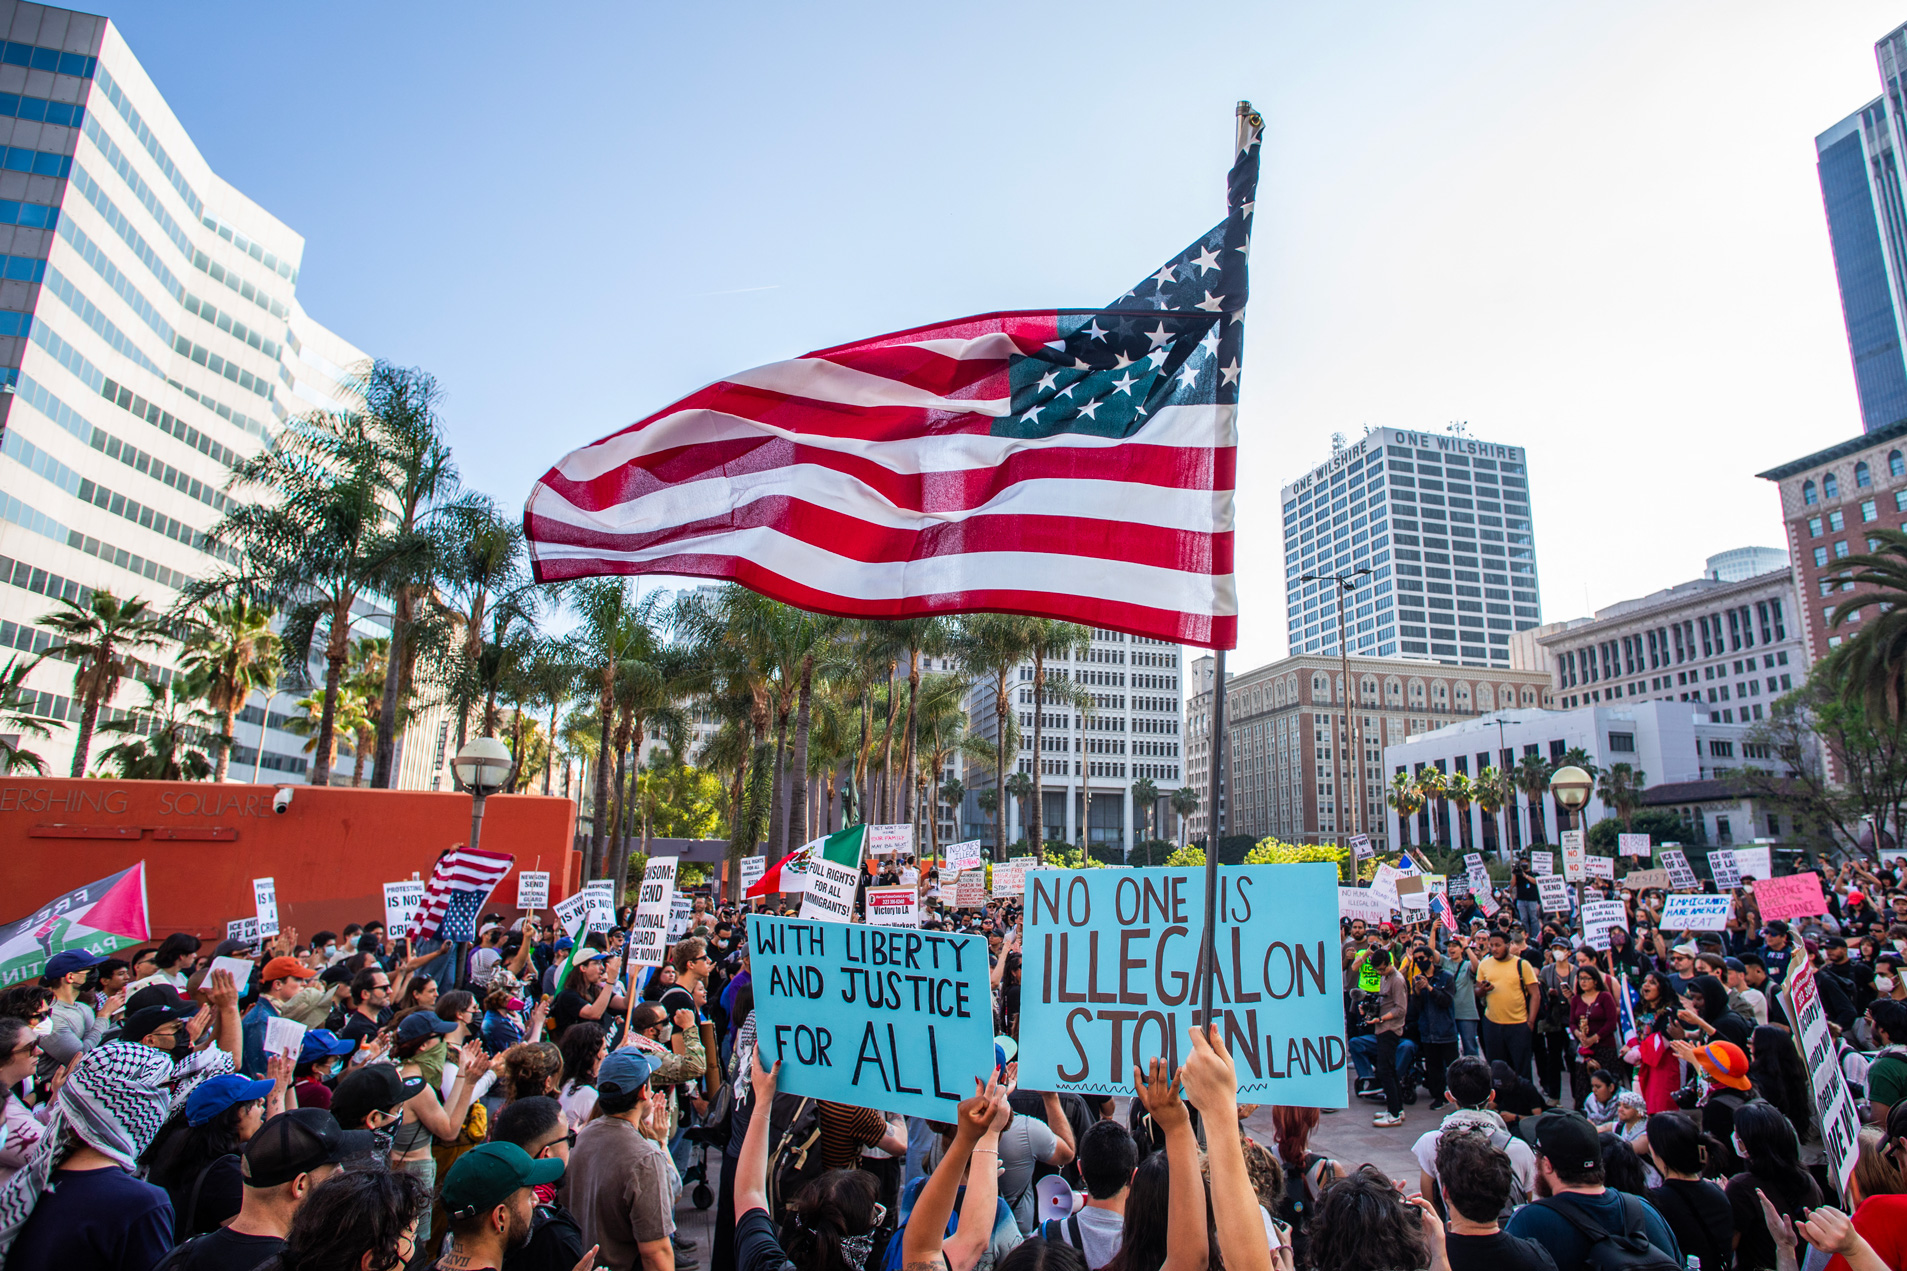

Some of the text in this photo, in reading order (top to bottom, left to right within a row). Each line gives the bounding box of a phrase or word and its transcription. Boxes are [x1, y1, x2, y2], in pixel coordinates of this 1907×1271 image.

[1395, 432, 1518, 461] ONE WILSHIRE
[1293, 440, 1368, 495] ONE WILSHIRE
[0, 788, 274, 818] ERSHING SQUARE
[950, 844, 960, 854] NO
[954, 850, 980, 860] ILLEGAL
[1568, 850, 1578, 858] NO
[946, 862, 956, 871] ON
[1569, 864, 1579, 872] NO
[1666, 860, 1676, 869] OF
[1712, 862, 1722, 870] OF
[645, 865, 674, 880] EWSOM:
[809, 862, 856, 886] FULL RIGHTS
[1626, 872, 1668, 883] RESIST
[386, 884, 423, 894] PROTESTING
[814, 880, 841, 898] FOR ALL
[1544, 884, 1562, 892] SEND
[1753, 877, 1788, 890] RESPECT
[640, 884, 664, 903] SEND
[1756, 884, 1803, 900] EXISTENCE
[258, 893, 266, 904] IS
[388, 894, 424, 908] IS NOT
[556, 895, 582, 913] PROTESTI
[585, 898, 613, 910] IS NOT
[804, 890, 850, 916] IMMIGRANTS!
[1032, 876, 1253, 927] NO ONE IS
[1669, 898, 1730, 906] IMMIGRANTS
[1760, 896, 1787, 908] EXPECT
[560, 905, 585, 924] IS NO
[669, 908, 690, 920] S NOT
[874, 906, 910, 916] Victory to LA
[1340, 908, 1384, 919] STOLEN LAND
[1666, 906, 1727, 918] MAKE AMERICA
[1760, 900, 1818, 918] RESISTANCE
[404, 912, 411, 922] A
[602, 913, 606, 921] A
[634, 914, 666, 929] ATIONAL
[1406, 912, 1426, 923] OF LA!
[1584, 916, 1625, 926] IMMIGRANTS!
[1672, 917, 1716, 928] GREAT
[229, 922, 242, 931] ICE
[389, 924, 410, 936] CRI
[672, 924, 678, 932] A
[1596, 926, 1609, 934] STO
[229, 928, 258, 940] OF LA
[666, 934, 682, 943] RIME
[756, 920, 970, 972] WITH LIBERTY
[640, 948, 662, 962] NOW!
[1042, 926, 1326, 1006] ILLEGAL ON
[770, 965, 970, 1018] AND JUSTICE
[1799, 1002, 1820, 1038] ictory
[1057, 1007, 1346, 1084] STOLN LAND
[775, 1020, 961, 1101] FOR ALL
[1817, 1088, 1834, 1122] hen
